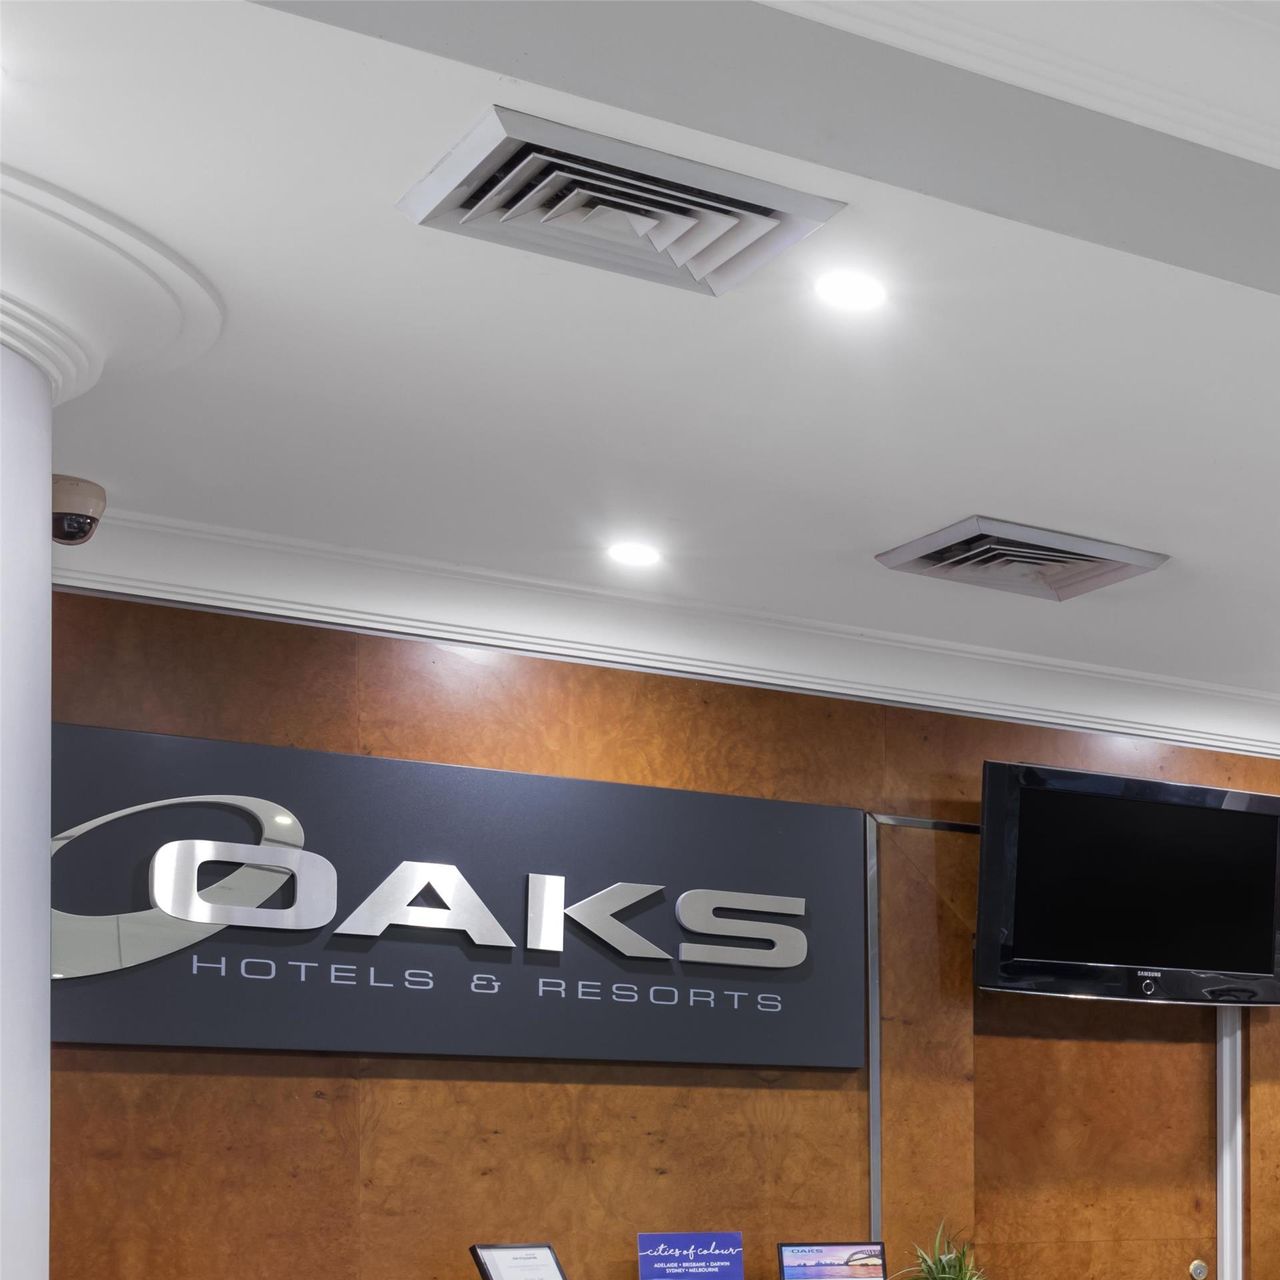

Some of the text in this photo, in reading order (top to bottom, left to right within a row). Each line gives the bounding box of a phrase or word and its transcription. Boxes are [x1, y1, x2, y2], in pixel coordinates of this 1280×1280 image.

[149, 839, 808, 969] OAKS
[191, 954, 783, 1013] HOTELS & RESORTS
[639, 1241, 743, 1260] cities of colour
